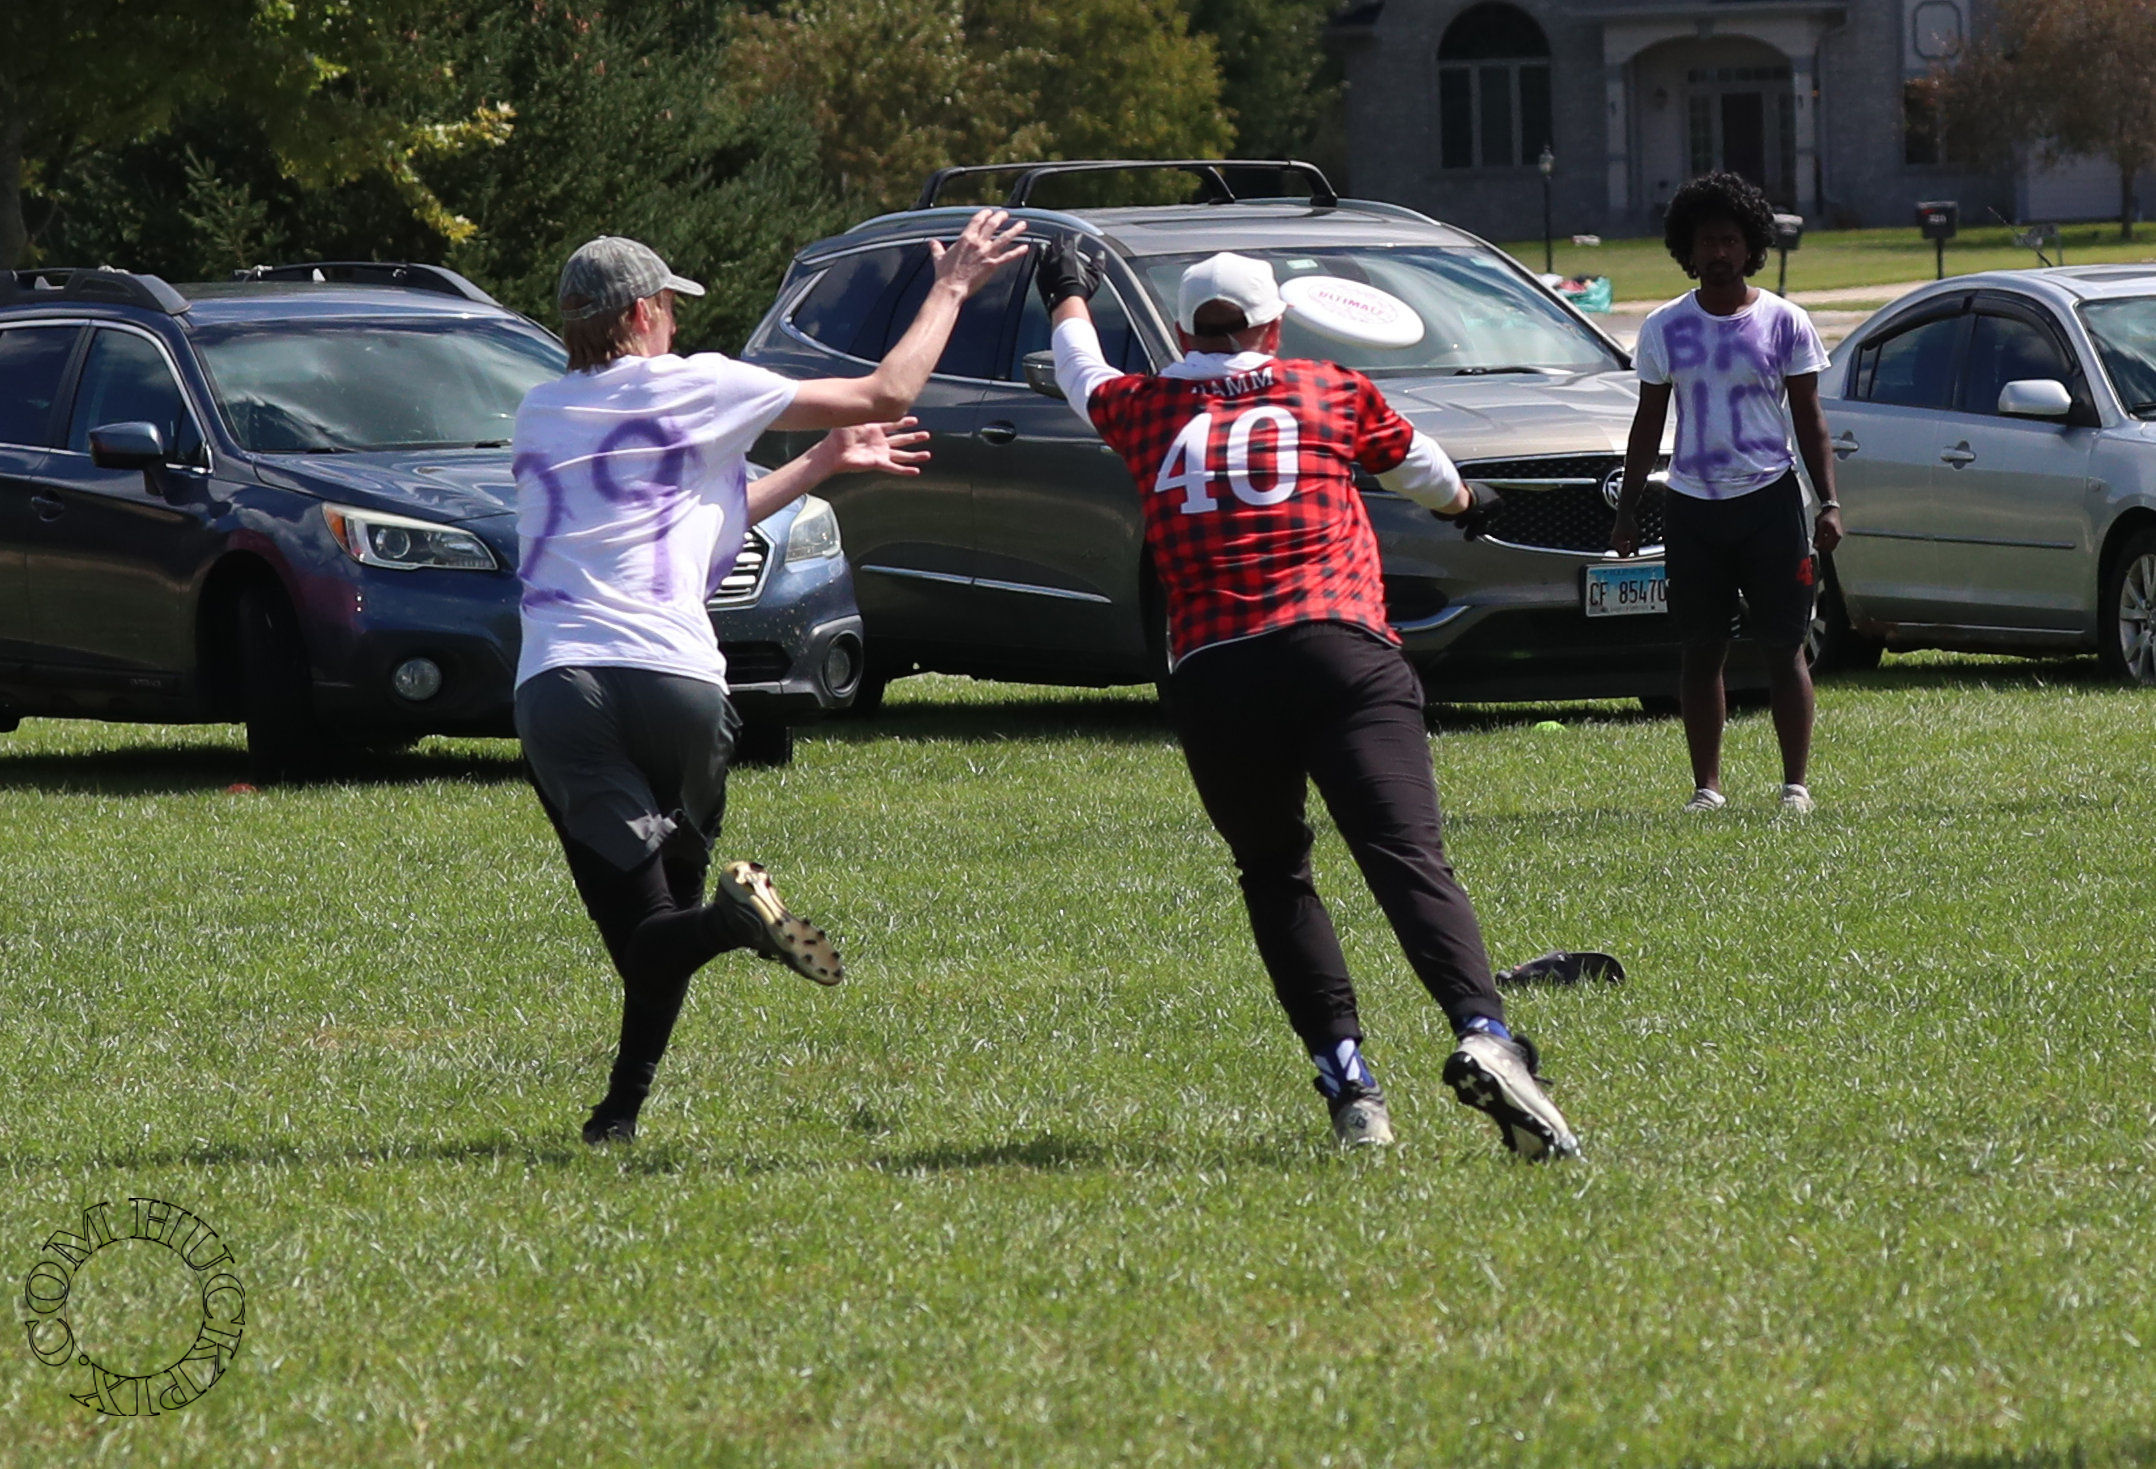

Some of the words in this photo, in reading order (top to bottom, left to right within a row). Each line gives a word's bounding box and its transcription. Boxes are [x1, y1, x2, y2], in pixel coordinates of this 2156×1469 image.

[1154, 405, 1299, 514] 40
[1589, 581, 1609, 607] CF
[1618, 579, 1667, 604] 85470
